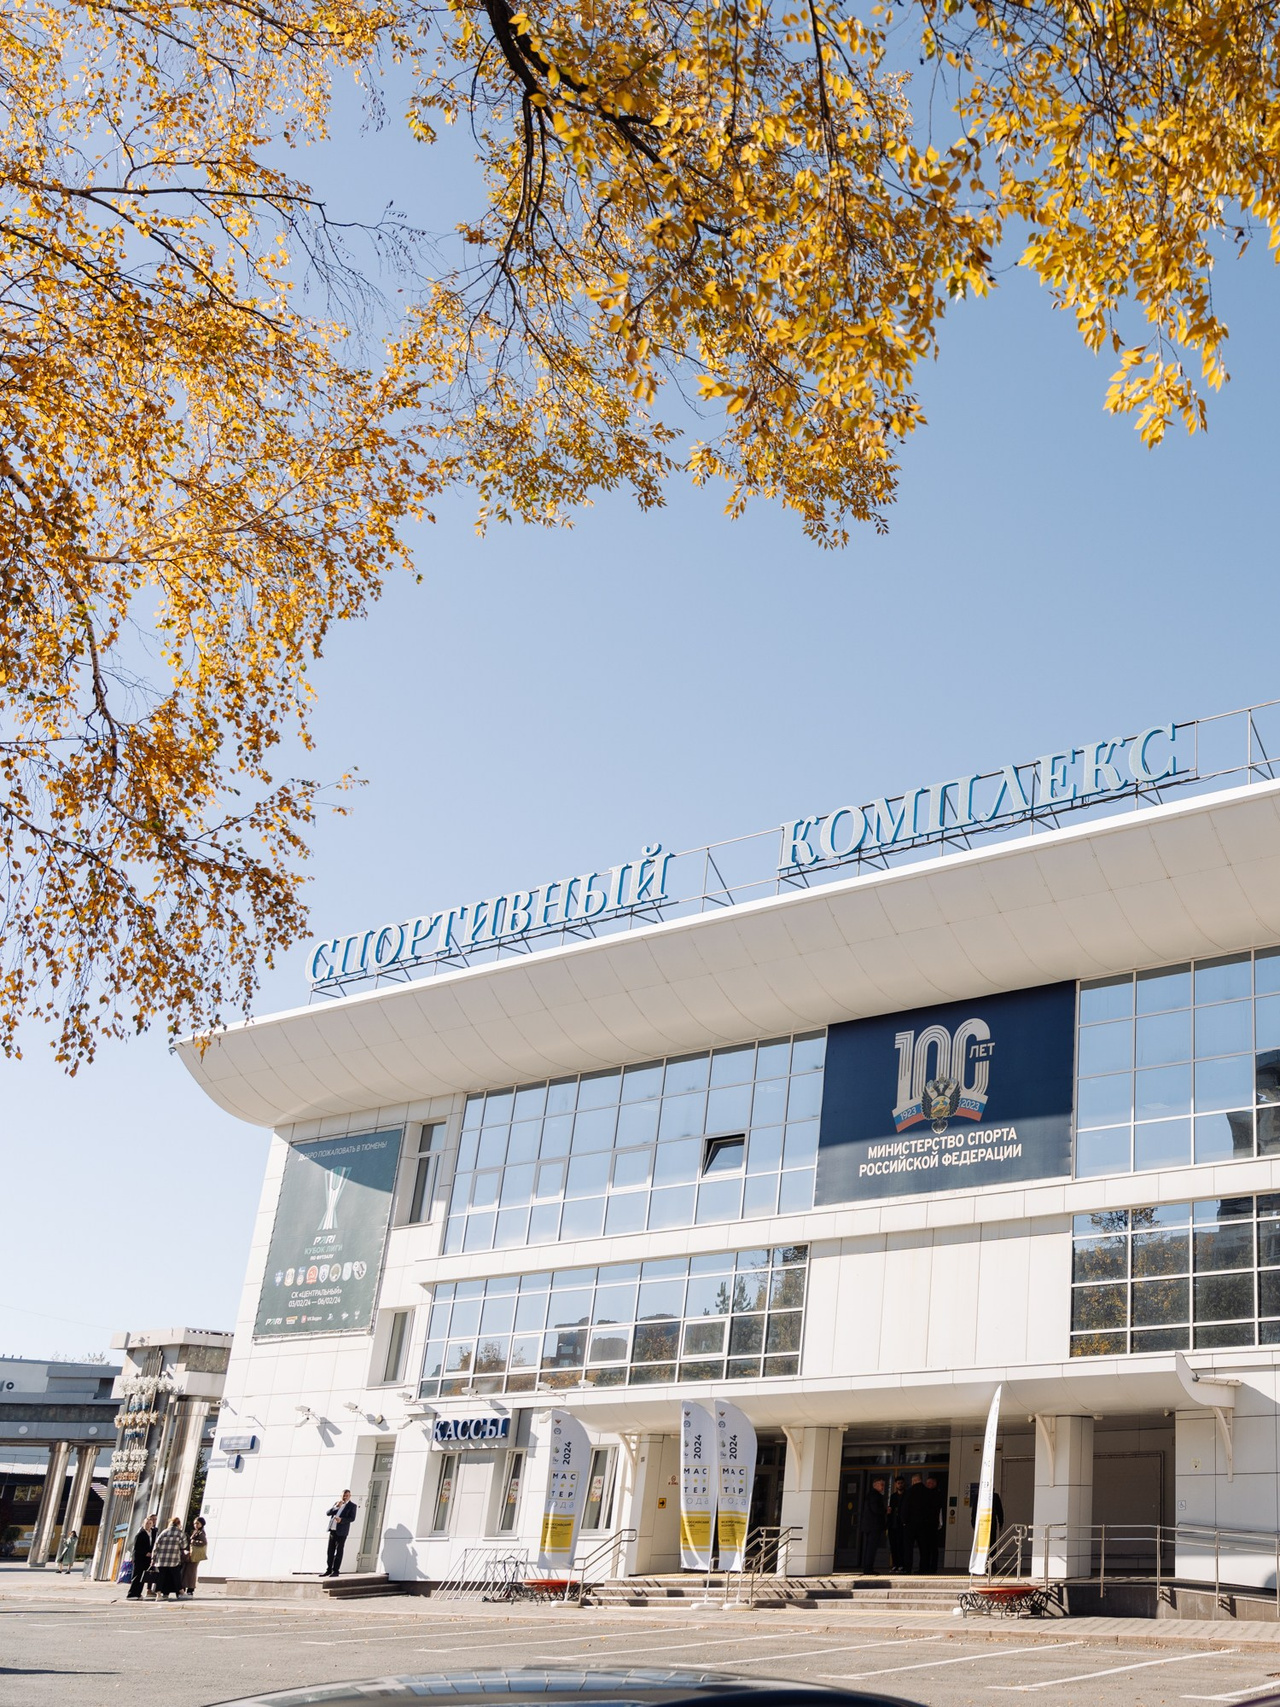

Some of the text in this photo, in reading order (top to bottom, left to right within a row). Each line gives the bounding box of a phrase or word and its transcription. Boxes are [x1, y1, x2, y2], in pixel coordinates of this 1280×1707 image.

[305, 842, 676, 985] СПОРТИВНЫЙ
[777, 722, 1178, 871] КОМПЛЕКС
[969, 1042, 996, 1059] ЛЕТ
[899, 1099, 980, 1121] 1923 2023
[318, 1147, 356, 1158] ПОЖАЛОВАТЬ
[867, 1127, 1018, 1159] МИНИСТЕРСТВО СПОРТА
[859, 1144, 1023, 1178] РОССИЙСКОЙ ФЕДЕРАЦИИ
[304, 1245, 326, 1255] КУБОК
[431, 1417, 509, 1442] КАССЫ
[562, 1441, 572, 1465] 2024
[693, 1433, 702, 1459] 2024
[729, 1434, 738, 1460] 2024
[552, 1472, 577, 1481] МАС
[683, 1467, 708, 1475] МАС
[551, 1490, 574, 1499] ТЕР
[684, 1486, 707, 1494] ТЕР
